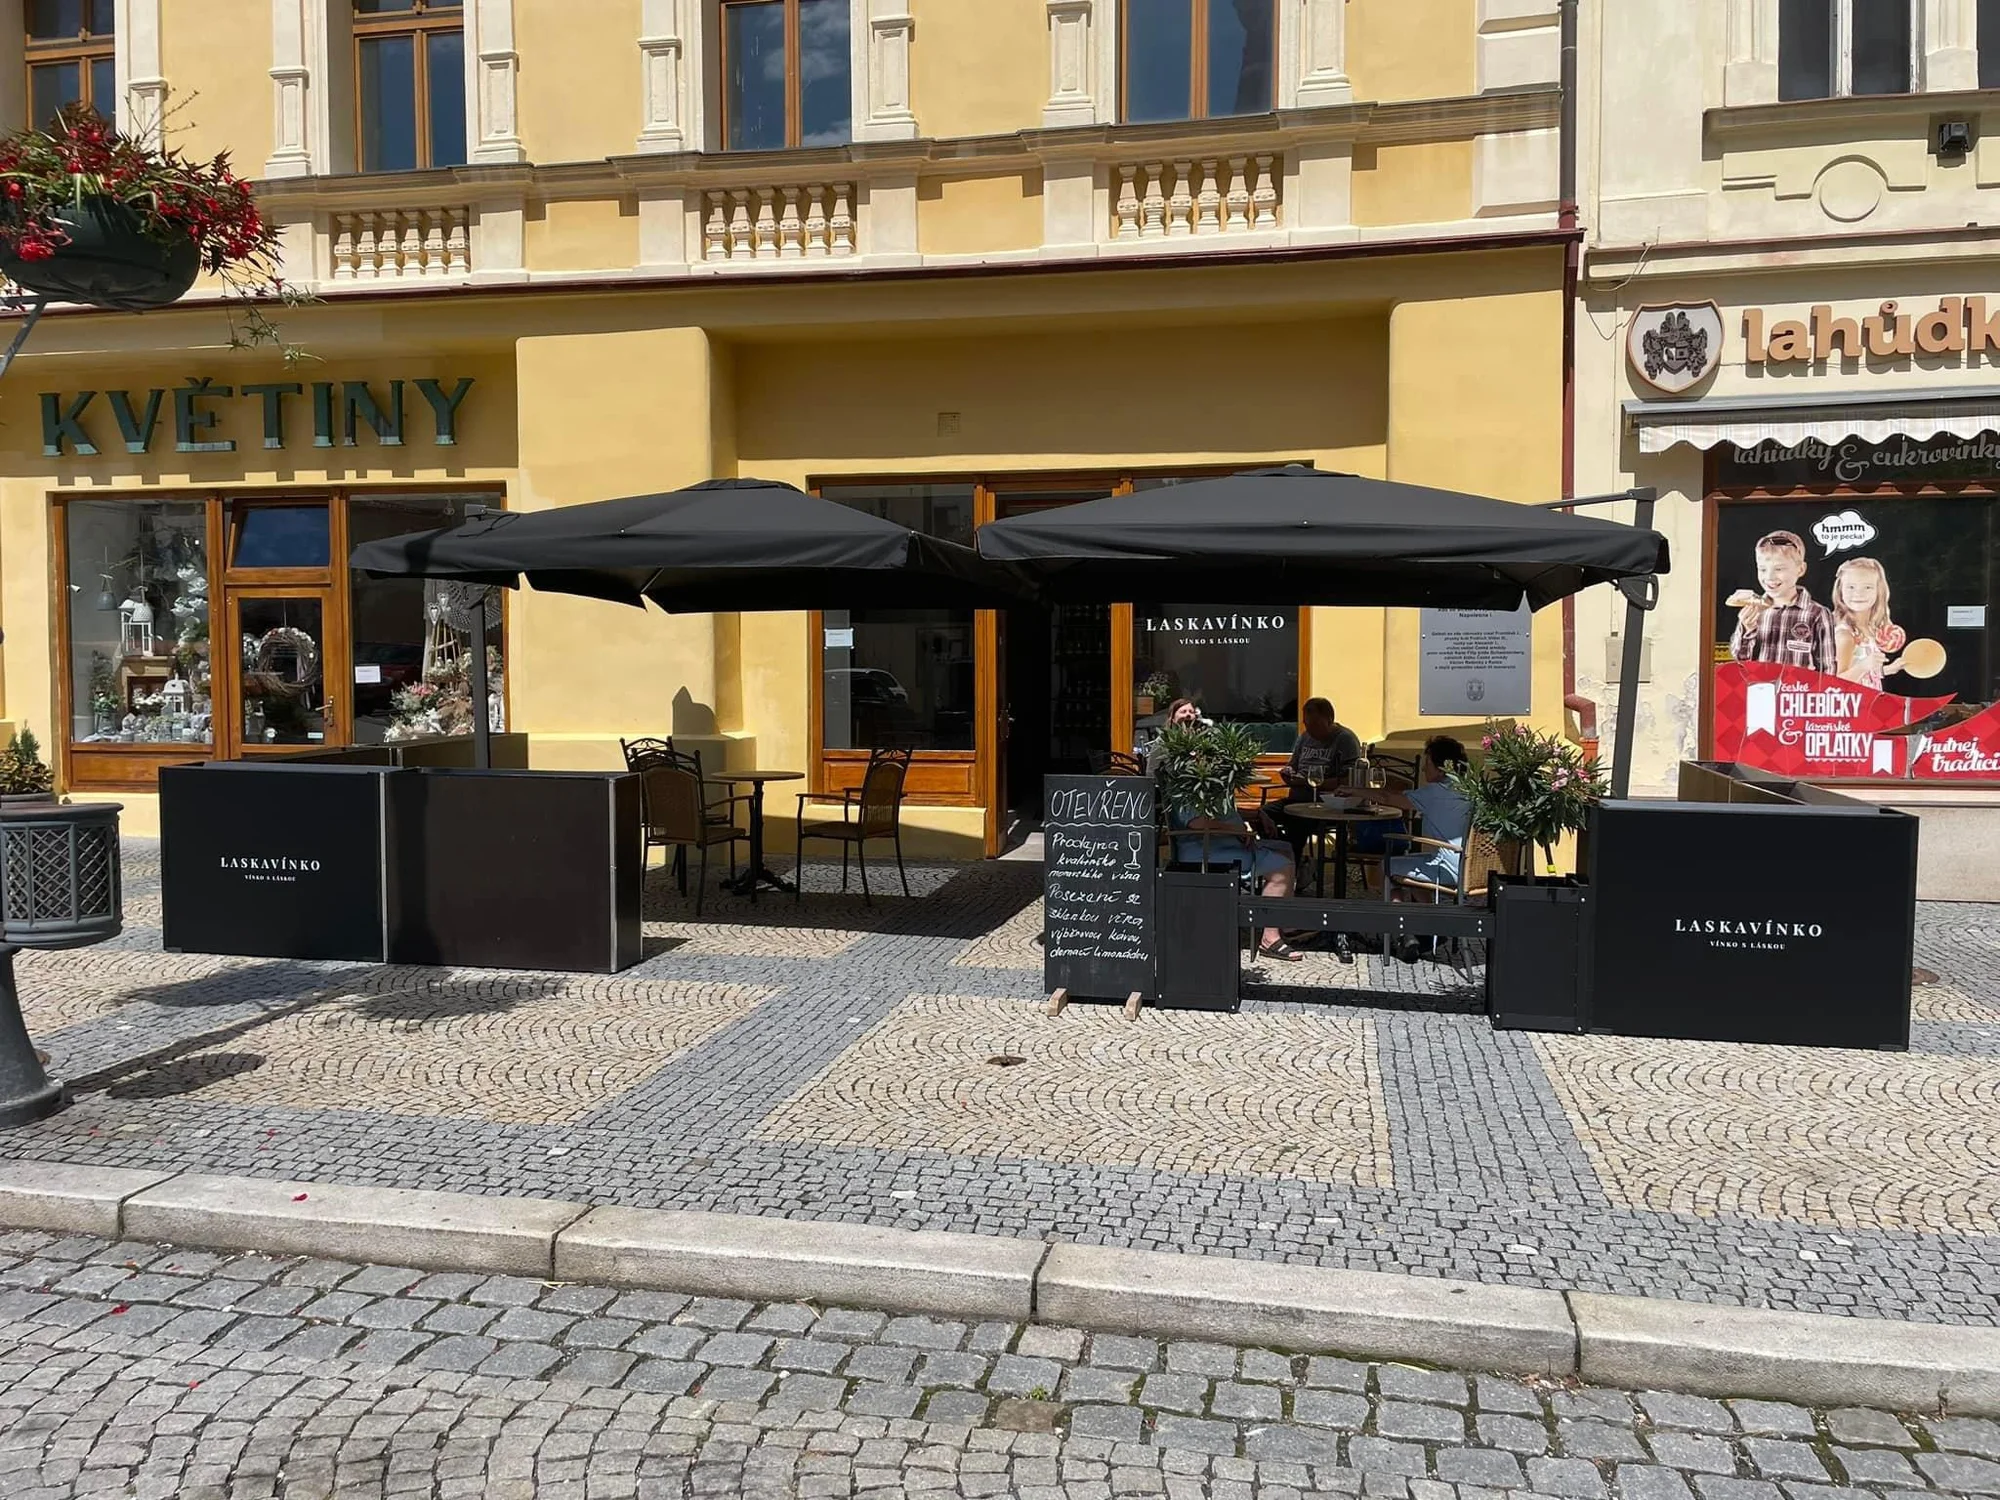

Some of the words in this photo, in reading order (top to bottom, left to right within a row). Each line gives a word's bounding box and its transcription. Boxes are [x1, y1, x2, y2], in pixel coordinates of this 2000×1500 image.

[38, 377, 475, 456] KVĚTINY
[1835, 443, 1870, 481] &
[1821, 523, 1865, 533] hmmm
[1831, 533, 1838, 541] je
[1146, 614, 1285, 631] LASKAVÍNKO
[1179, 637, 1206, 645] VÍNKO
[1217, 636, 1250, 645] LÁSKOU
[1781, 681, 1810, 692] české
[1780, 686, 1863, 718] CHLEBÍČKY
[1778, 719, 1803, 745] &
[1805, 720, 1852, 732] lázeňské
[1805, 732, 1874, 757] OPLATKY
[1051, 780, 1153, 820] OTEVŘENO
[1052, 832, 1120, 858] Prodejna
[220, 856, 321, 871] LASKAVÍNKO
[1111, 871, 1142, 882] vína
[1675, 918, 1823, 937] LASKAVÍNKO
[1710, 940, 1738, 948] VÍNKO
[1750, 941, 1785, 950] LÁSKOU
